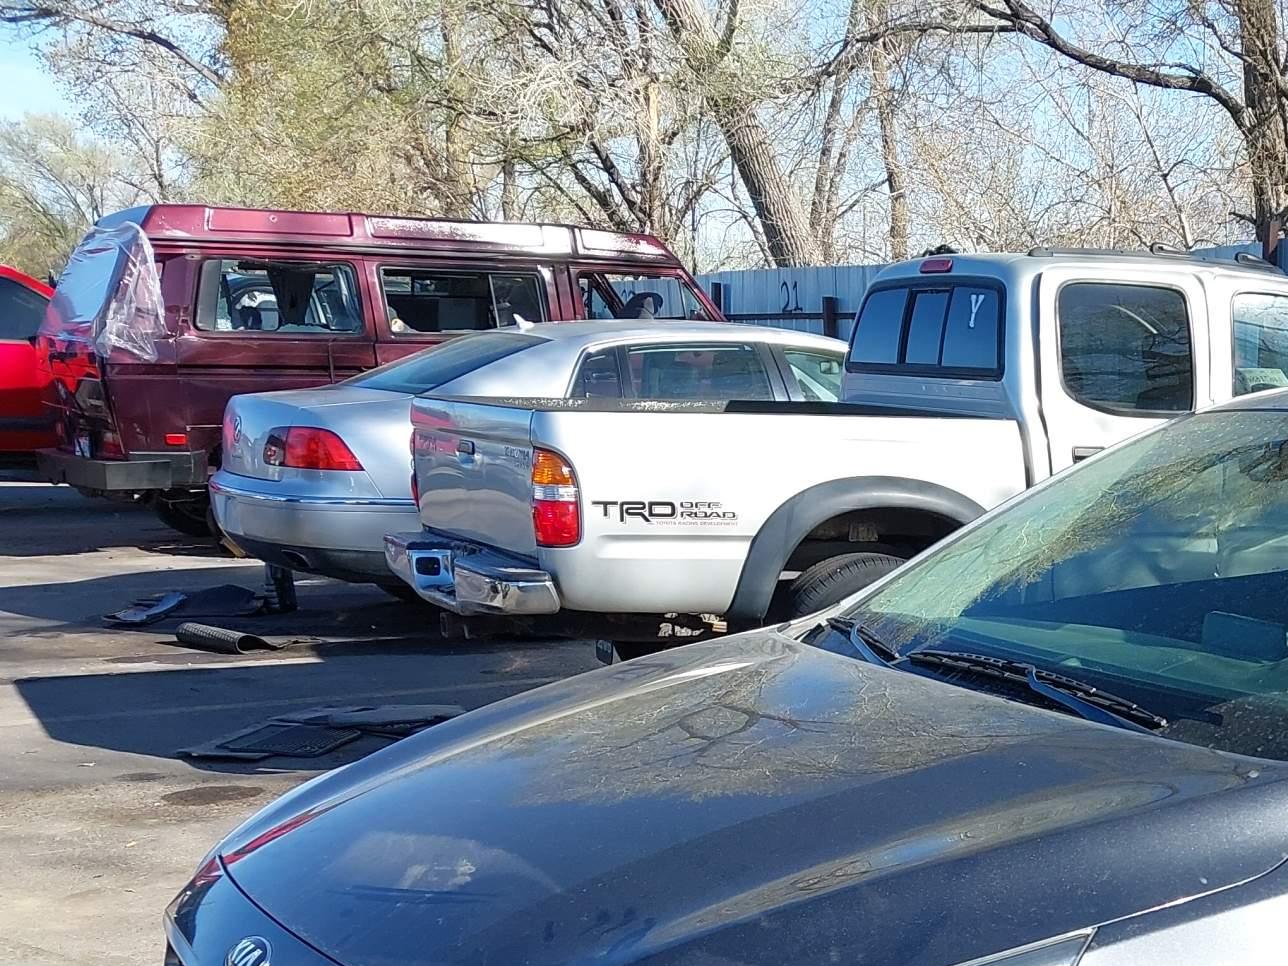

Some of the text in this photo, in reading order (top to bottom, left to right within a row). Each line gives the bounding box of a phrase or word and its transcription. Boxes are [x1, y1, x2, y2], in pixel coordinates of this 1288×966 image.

[780, 280, 804, 313] 21
[591, 500, 677, 524] TRD
[679, 501, 722, 510] OFF
[679, 511, 738, 520] ROAD
